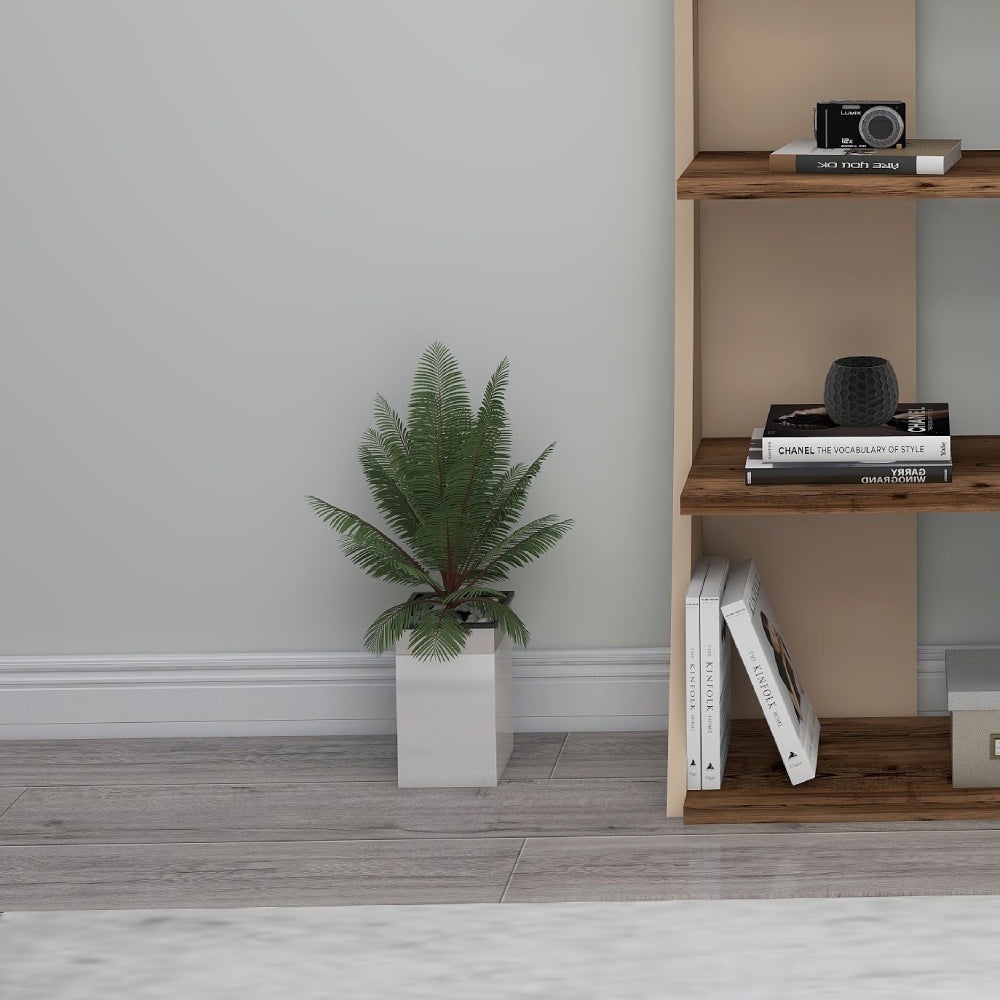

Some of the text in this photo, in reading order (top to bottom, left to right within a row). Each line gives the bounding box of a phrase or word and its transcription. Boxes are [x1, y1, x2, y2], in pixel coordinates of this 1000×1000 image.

[907, 407, 926, 433] CHANEL
[778, 446, 814, 455] CHANEL
[752, 665, 777, 710] KINFOLK
